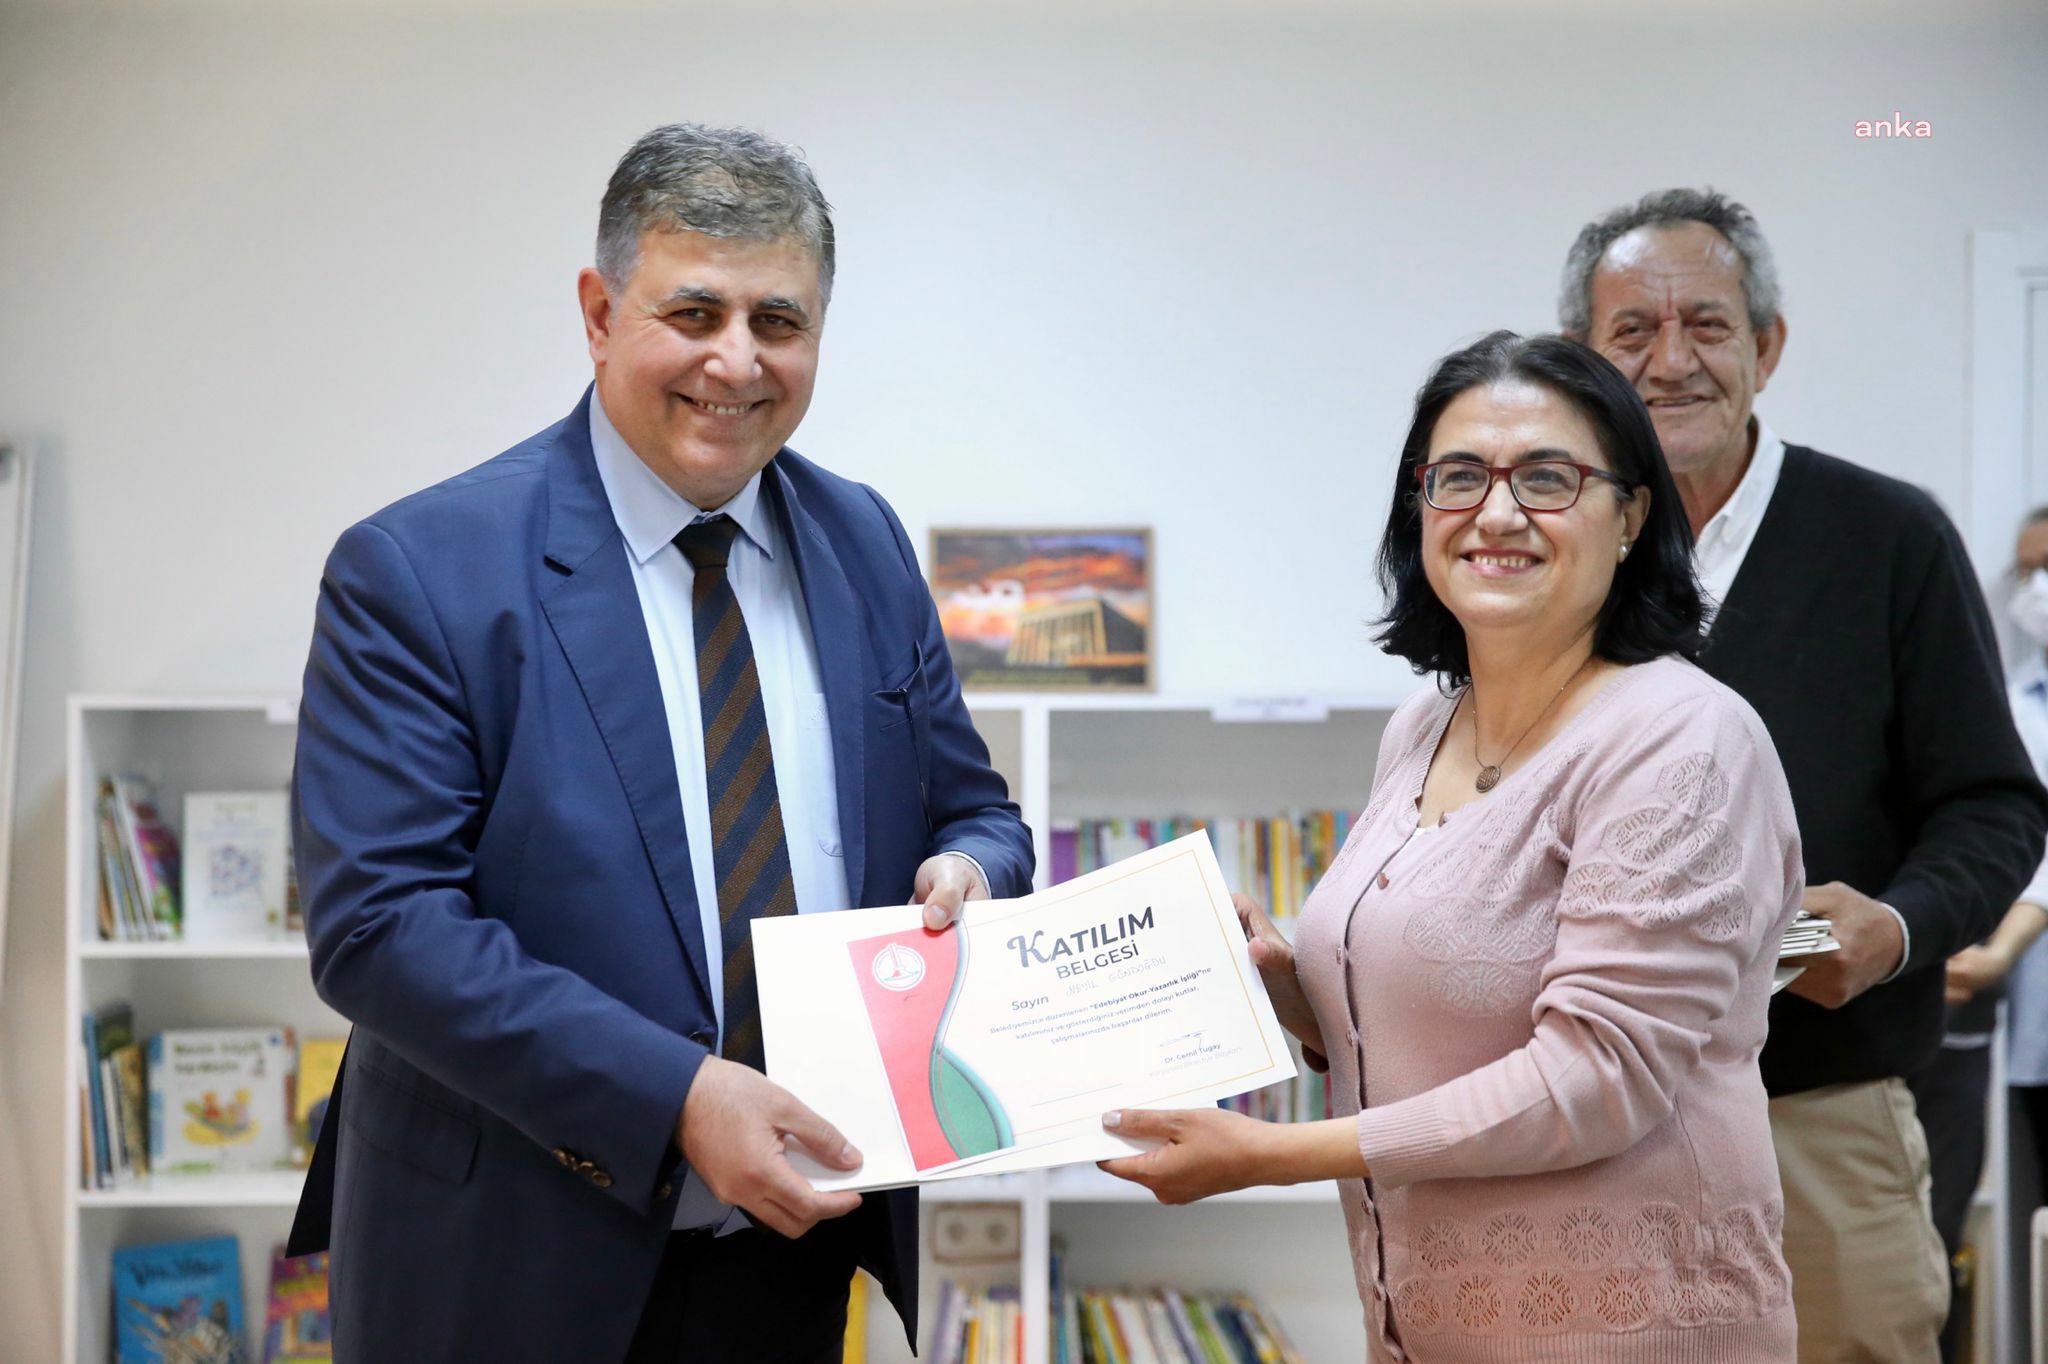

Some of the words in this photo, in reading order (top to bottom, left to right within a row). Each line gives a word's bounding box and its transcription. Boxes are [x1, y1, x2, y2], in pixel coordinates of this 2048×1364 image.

[1006, 906, 1155, 968] KATILIM
[1055, 939, 1140, 980] BELGESİ
[1128, 978, 1180, 1000] Okur-Yazarlık
[1011, 996, 1049, 1011] Sayın
[1199, 1043, 1221, 1055] Tugay
